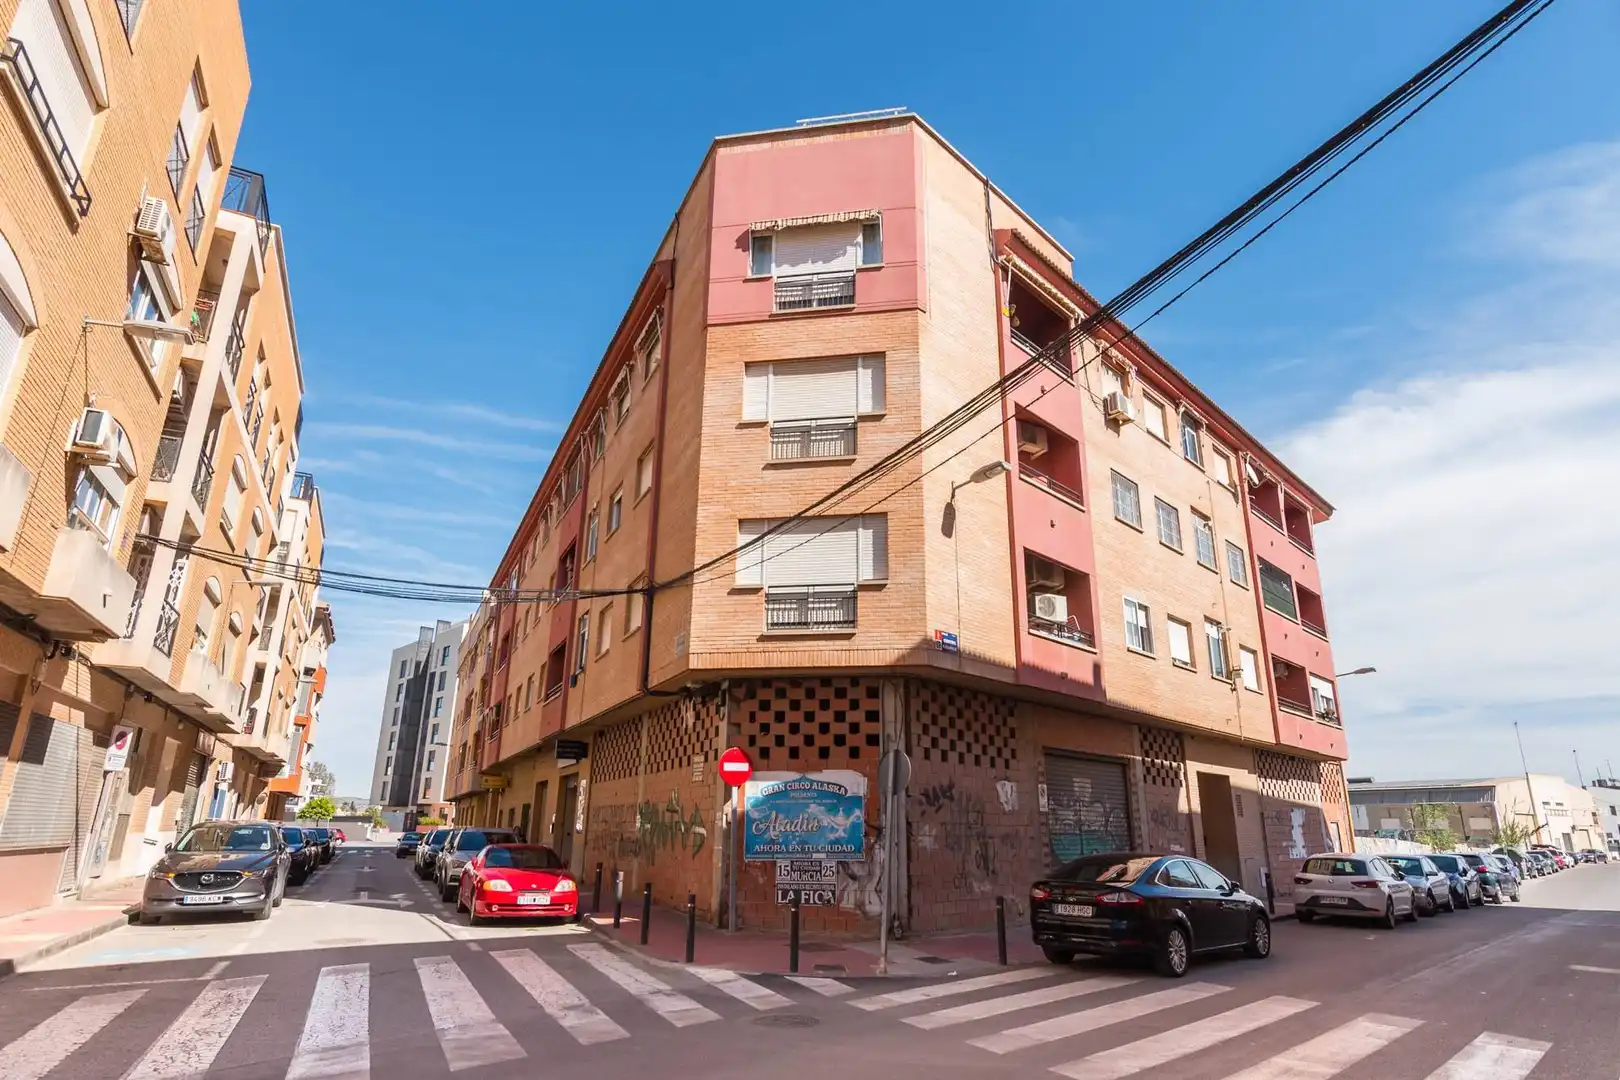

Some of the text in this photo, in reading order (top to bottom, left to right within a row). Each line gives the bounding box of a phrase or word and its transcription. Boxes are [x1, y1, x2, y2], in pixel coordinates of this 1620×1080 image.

[762, 781, 847, 796] GRAN CIRCO ALASKA
[754, 844, 855, 852] AHORA EN TU CIUDAD
[778, 865, 790, 877] 15
[791, 871, 822, 881] MURCIA
[823, 865, 835, 878] 25
[777, 890, 835, 904] LA FICA
